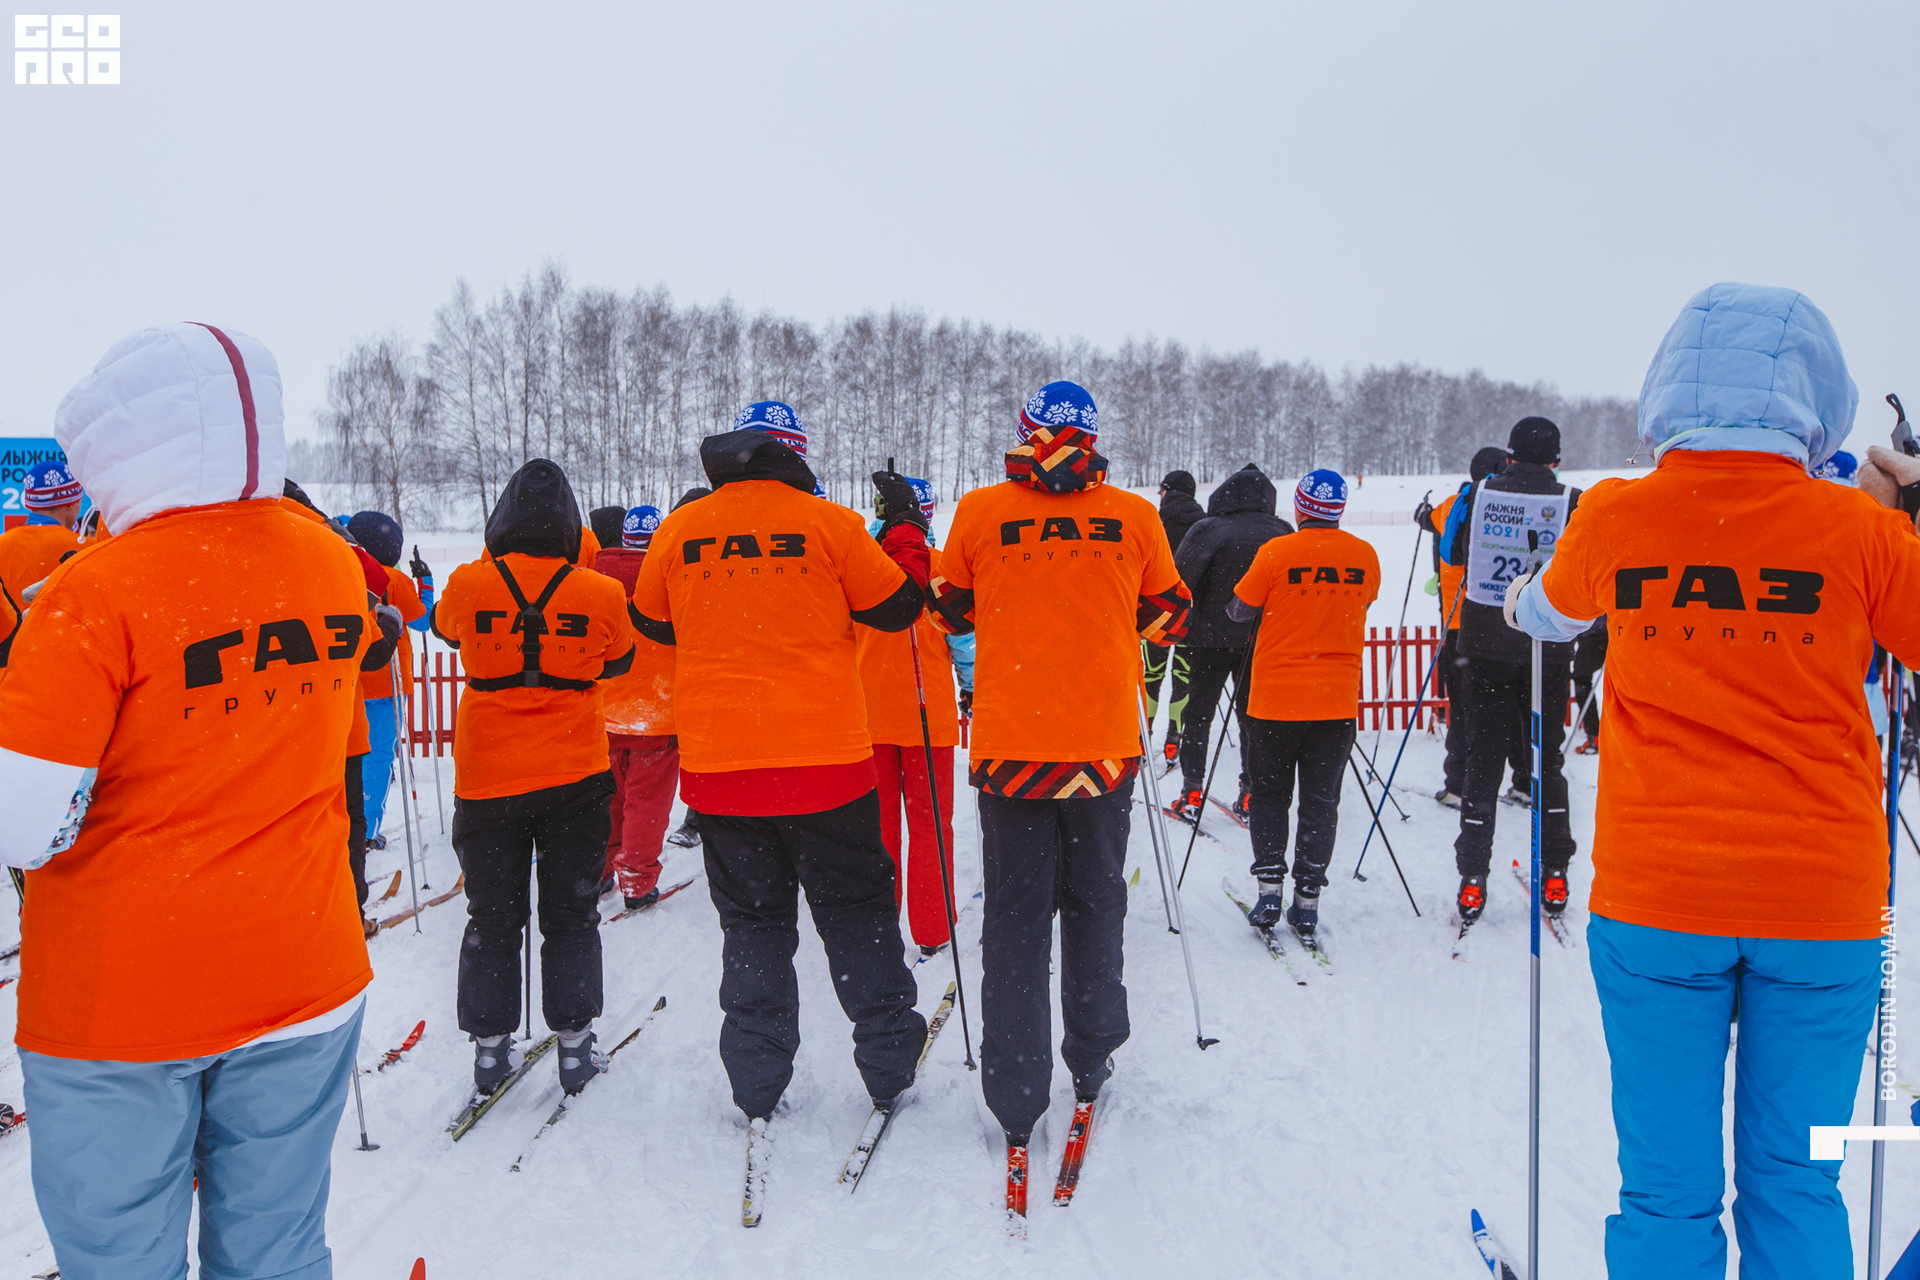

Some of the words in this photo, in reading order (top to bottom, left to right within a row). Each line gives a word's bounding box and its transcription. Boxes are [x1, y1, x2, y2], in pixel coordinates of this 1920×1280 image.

[1, 450, 68, 466] ЛЫЖНЯ
[2, 468, 27, 483] РО
[1484, 502, 1525, 515] ЛЫЖНЯ
[1484, 512, 1524, 526] РОССИИ
[1000, 516, 1123, 546] ГАЗ
[1483, 523, 1520, 538] 2021
[682, 533, 806, 565] ГАЗ
[1481, 542, 1500, 550] СПОРТ
[1002, 550, 1123, 563] группа
[684, 566, 808, 581] группа
[1288, 566, 1366, 585] ГАЗ
[1491, 555, 1528, 583] 23
[1287, 589, 1362, 597] группа
[1479, 582, 1508, 593] НИЖЕГ
[1615, 565, 1825, 615] ГАЗ
[1494, 593, 1506, 601] ОБ
[475, 610, 590, 638] ГАЗ
[1618, 625, 1814, 645] группа
[183, 614, 363, 690] ГАЗ
[184, 675, 356, 720] групп
